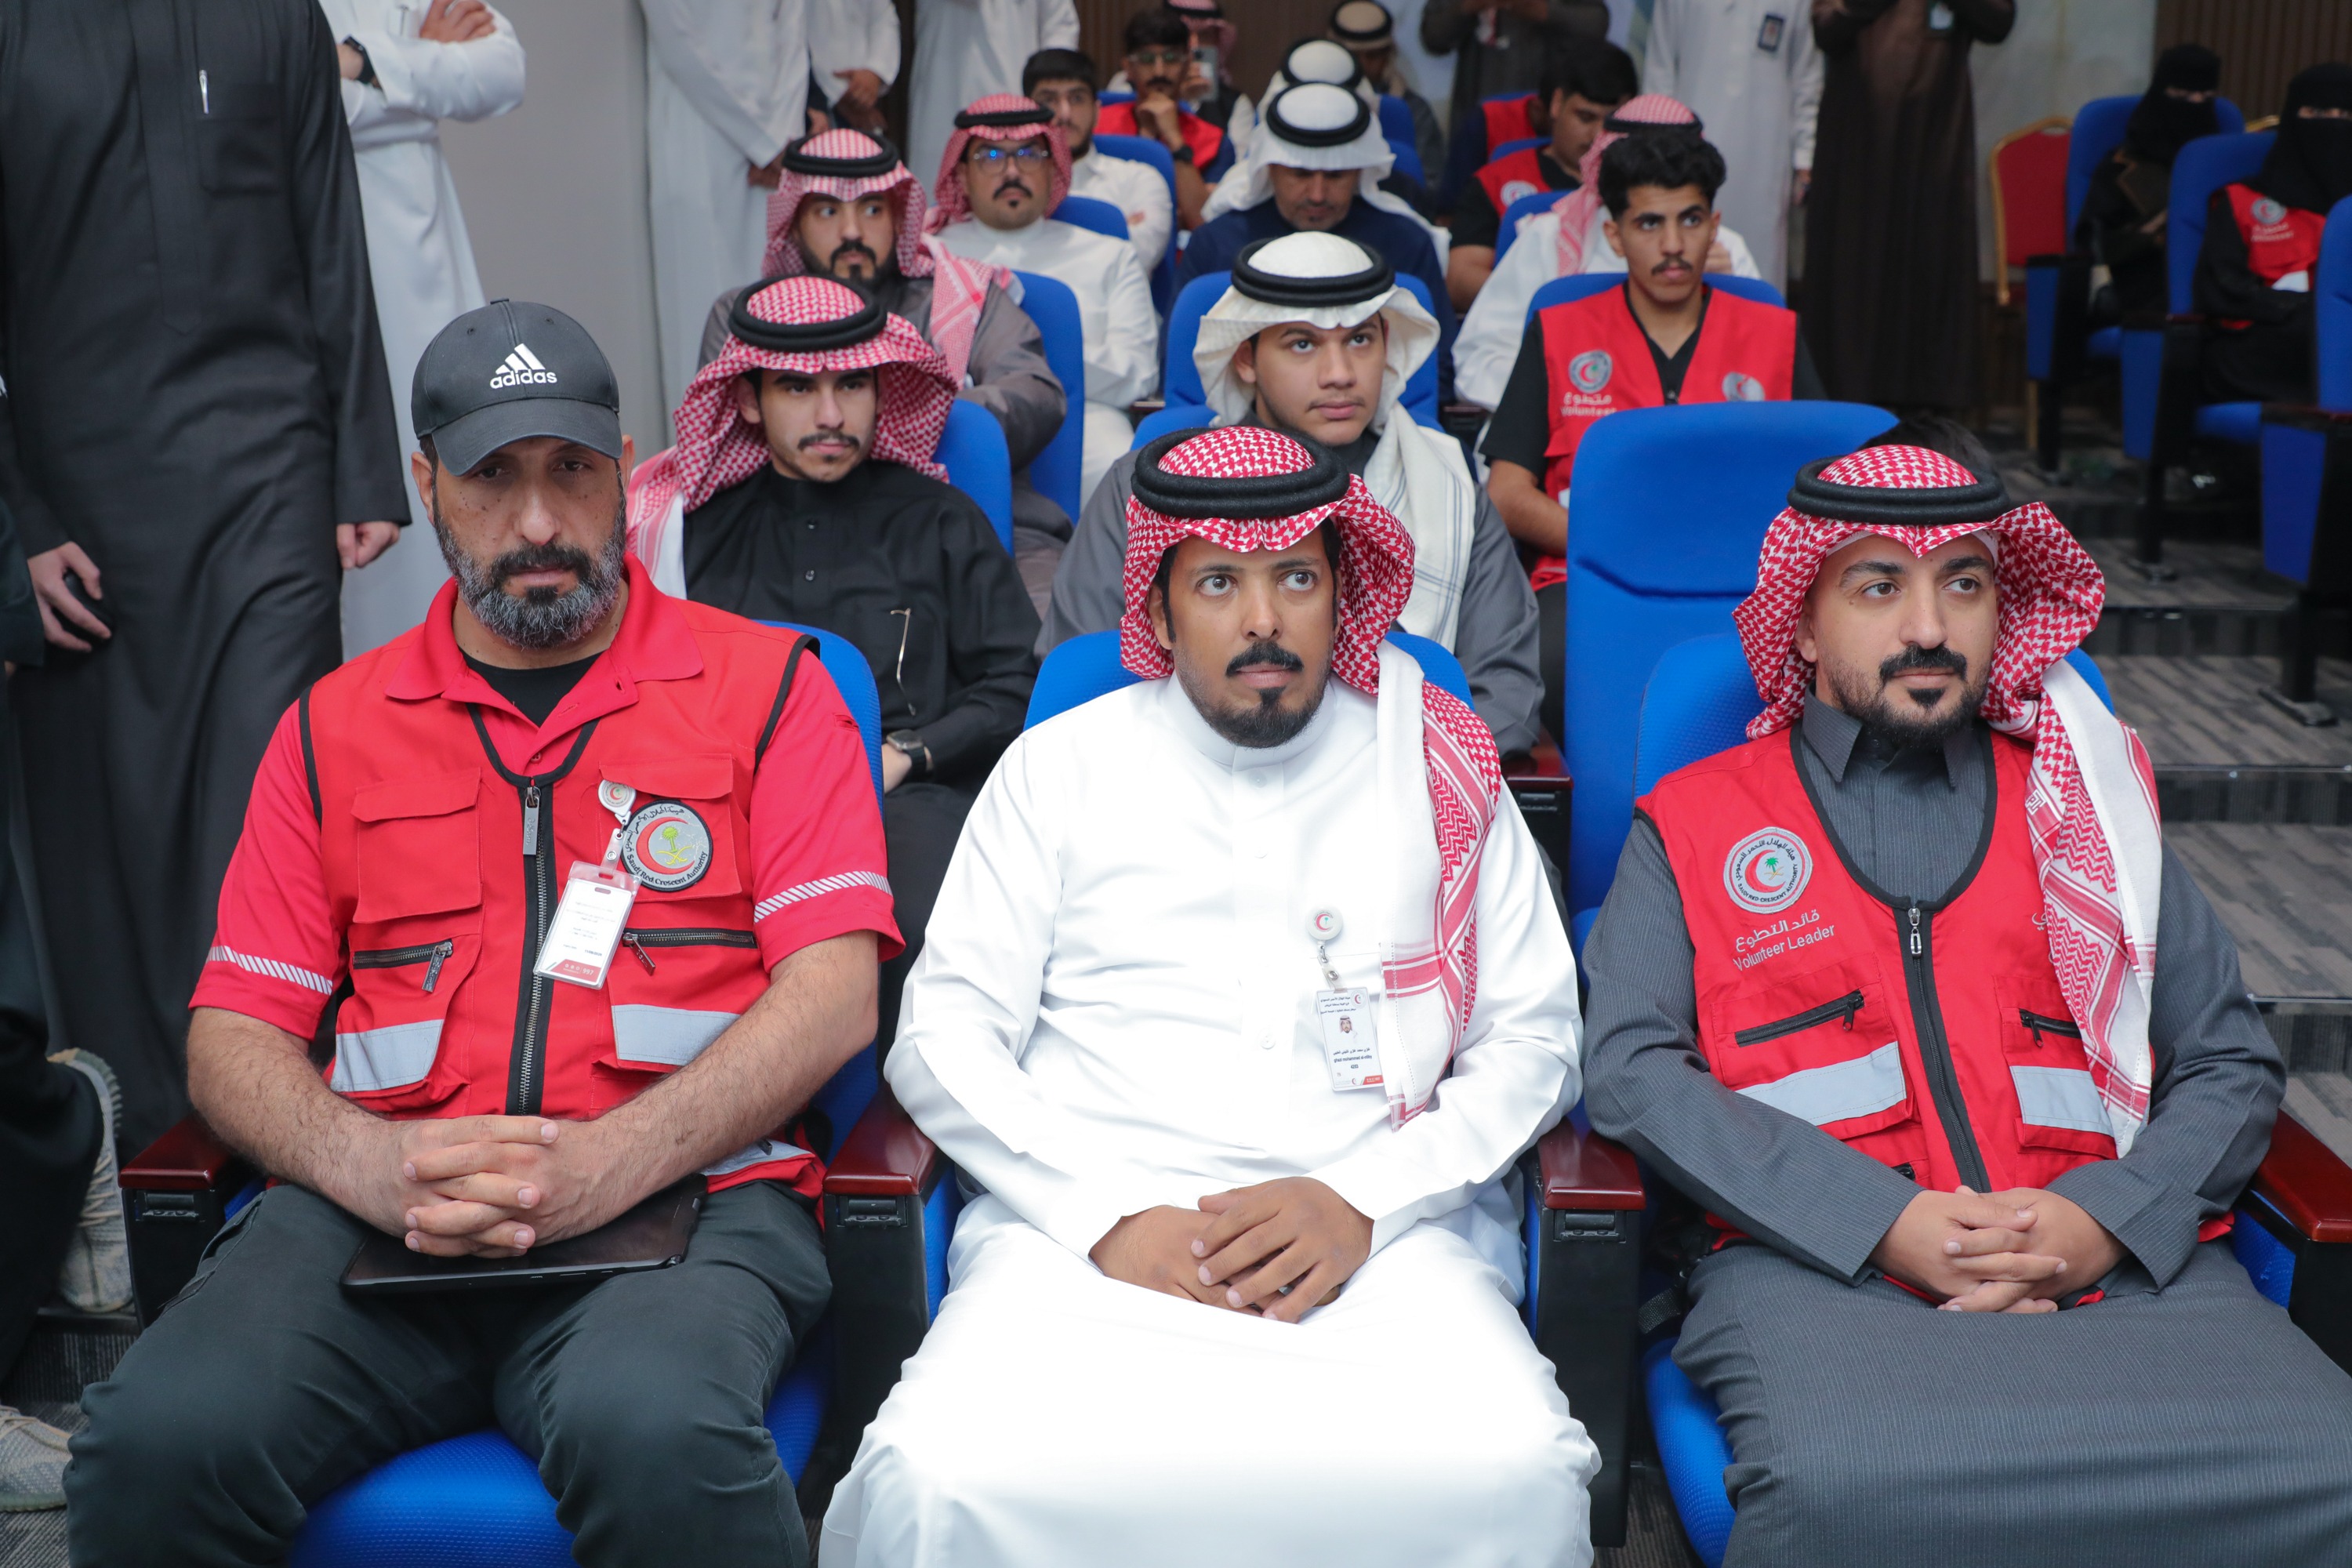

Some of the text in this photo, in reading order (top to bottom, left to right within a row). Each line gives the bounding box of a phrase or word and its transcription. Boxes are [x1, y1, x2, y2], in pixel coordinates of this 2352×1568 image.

[490, 368, 557, 389] adidas
[1563, 392, 1612, 405] متطوع
[627, 851, 708, 886] Saudi Red Crescent Authority
[1736, 838, 1795, 880] هيئة الهلال الأحمر السعودي
[1737, 883, 1749, 897] SAUDI
[1760, 891, 1787, 902] CRESCENT
[1786, 864, 1798, 892] AUTHORITY
[1733, 924, 1835, 971] Volunteer Leader
[1736, 909, 1820, 953] قائد التطوع
